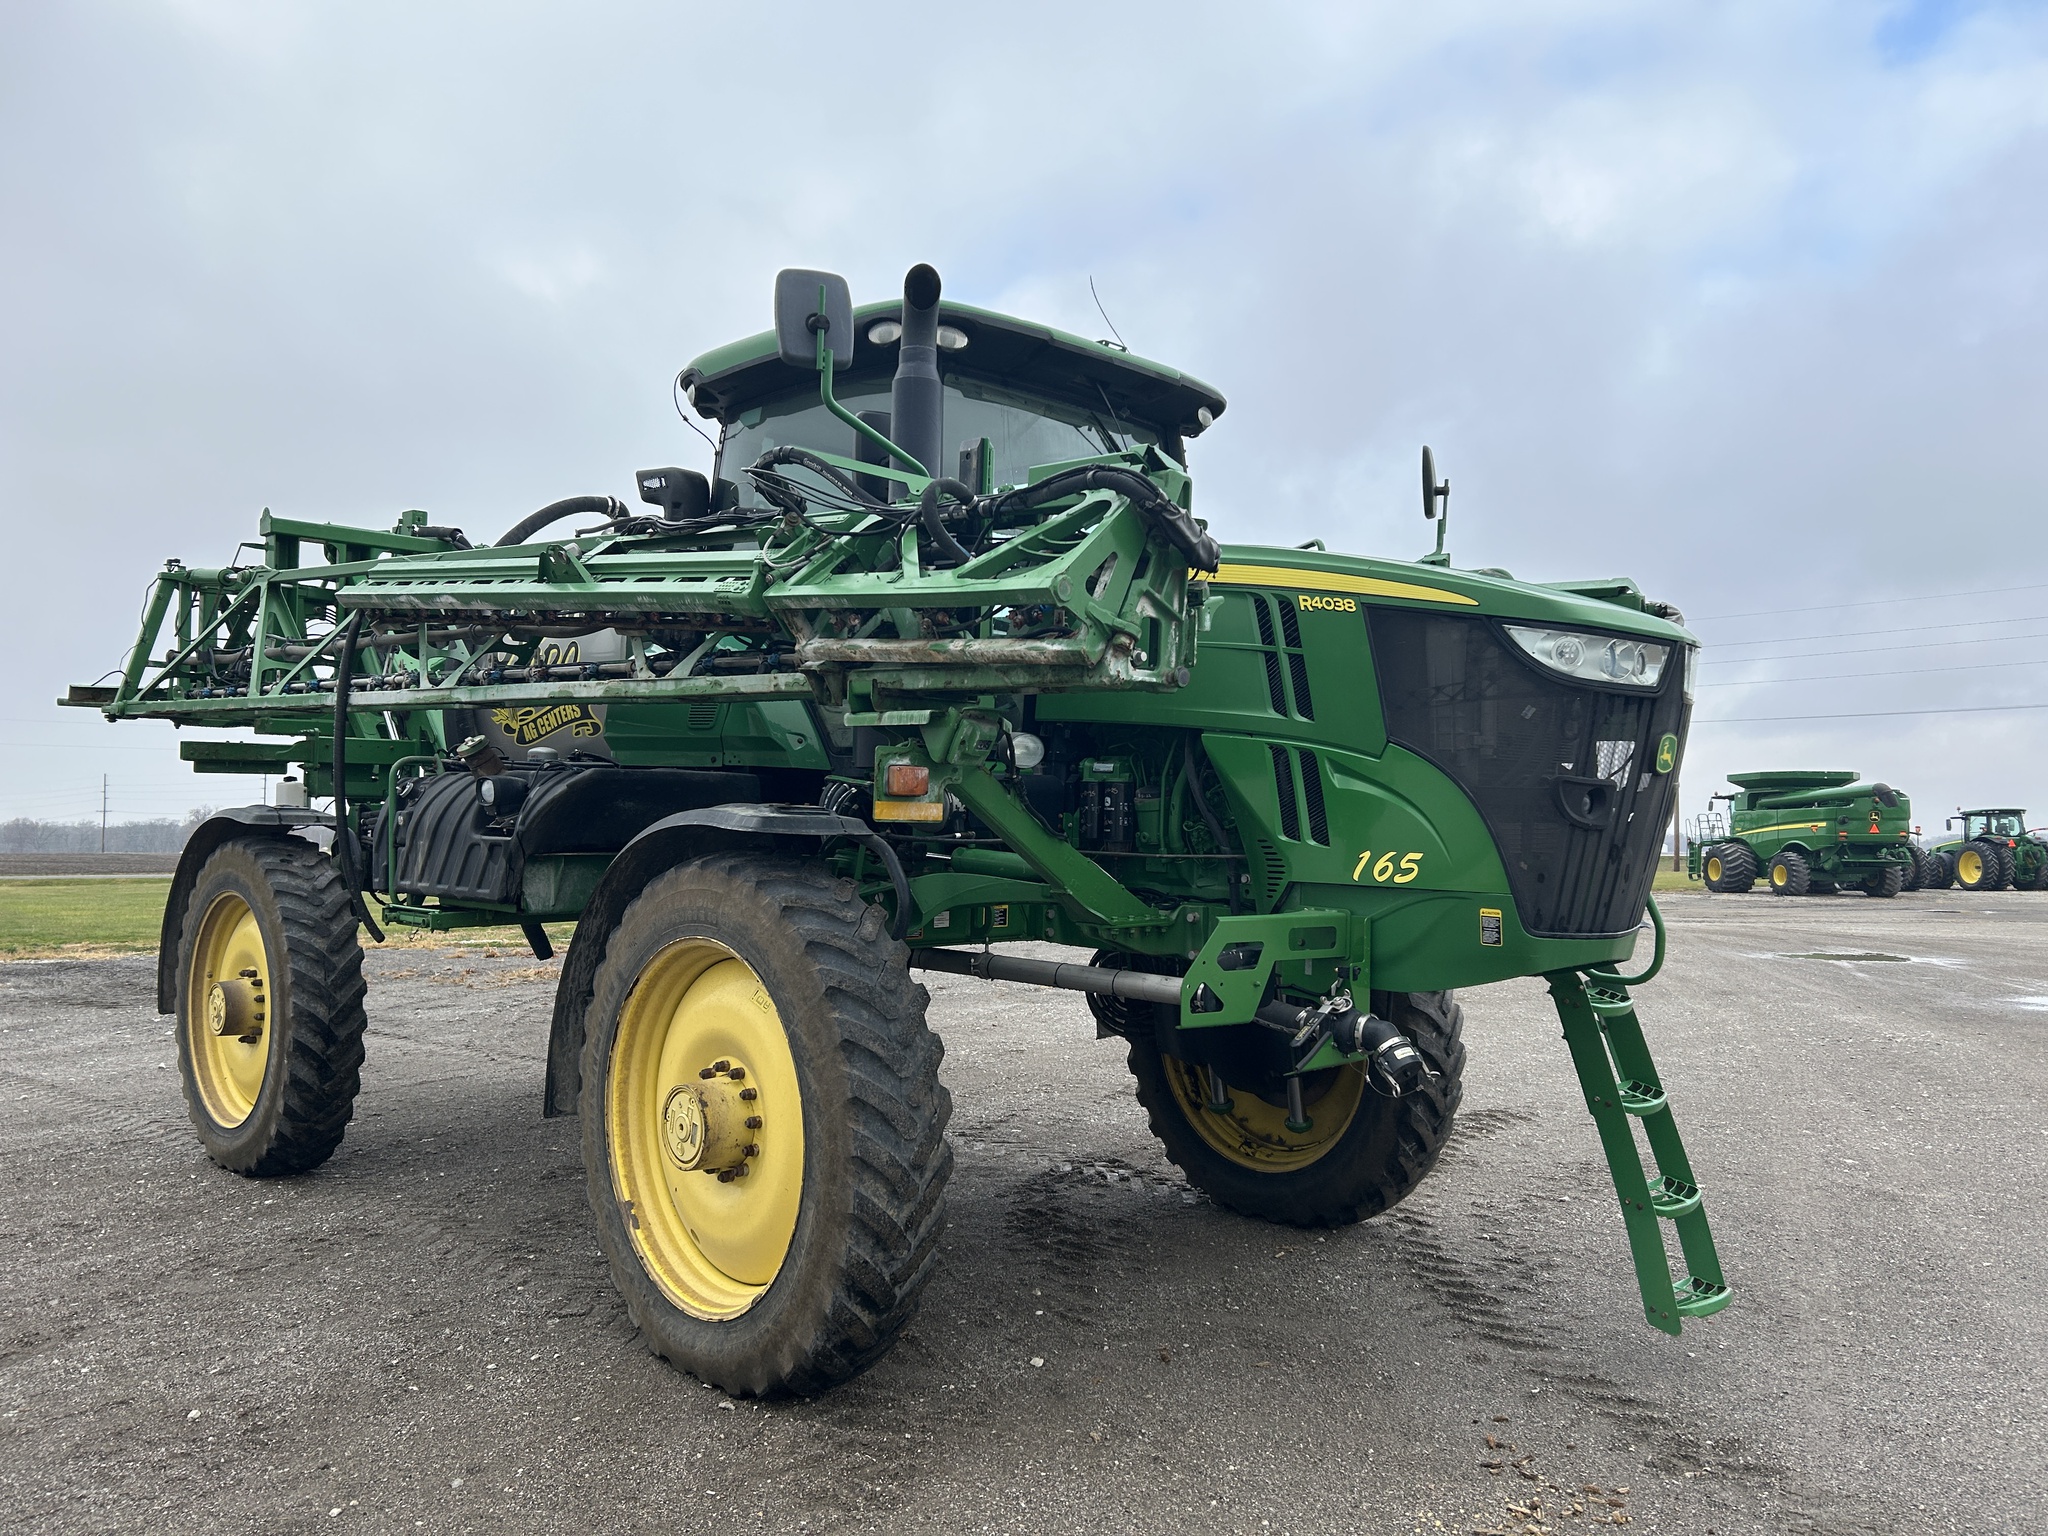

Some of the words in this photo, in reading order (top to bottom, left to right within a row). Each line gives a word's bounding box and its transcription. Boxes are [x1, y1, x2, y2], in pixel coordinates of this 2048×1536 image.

[1298, 595, 1357, 613] R4038
[522, 720, 539, 742] AG
[536, 704, 582, 732] CENTERS
[1352, 850, 1424, 884] 165
